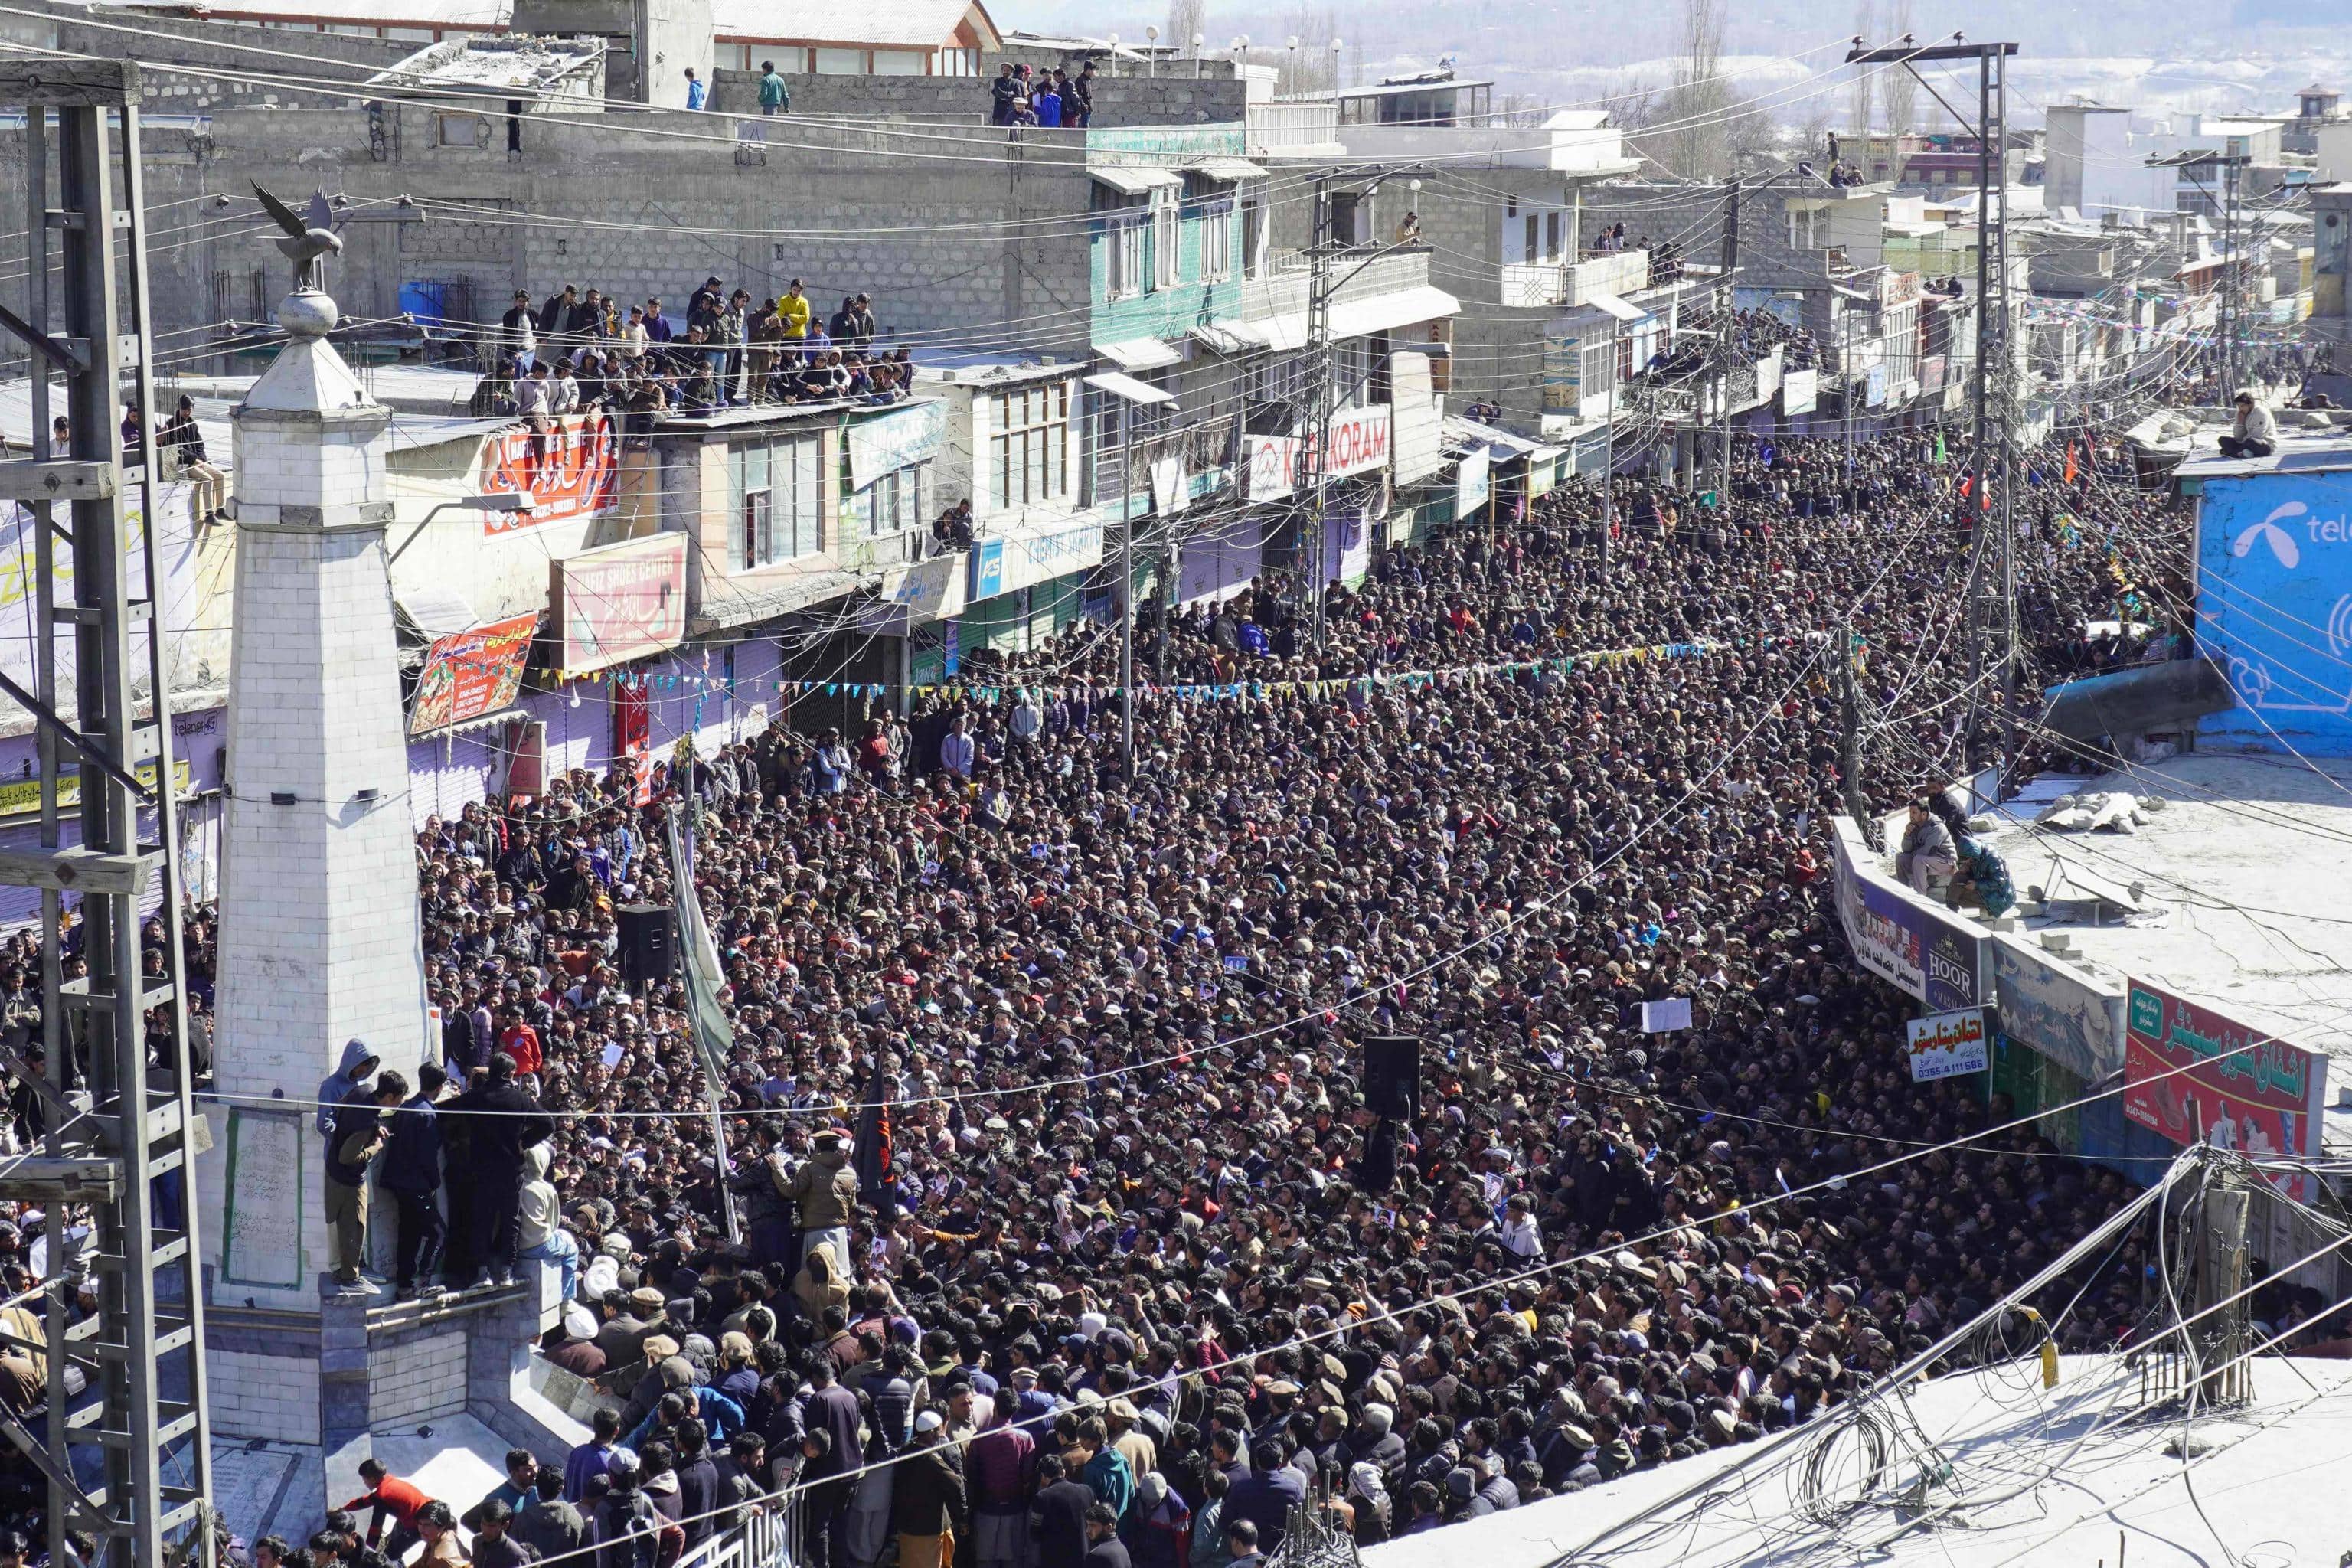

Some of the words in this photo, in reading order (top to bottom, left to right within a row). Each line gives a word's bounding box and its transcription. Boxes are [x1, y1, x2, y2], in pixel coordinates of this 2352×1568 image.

[2306, 514, 2352, 543] tel
[639, 554, 674, 580] CENTER
[1929, 952, 1971, 999] HOOR
[2255, 1042, 2307, 1102] اشفاق
